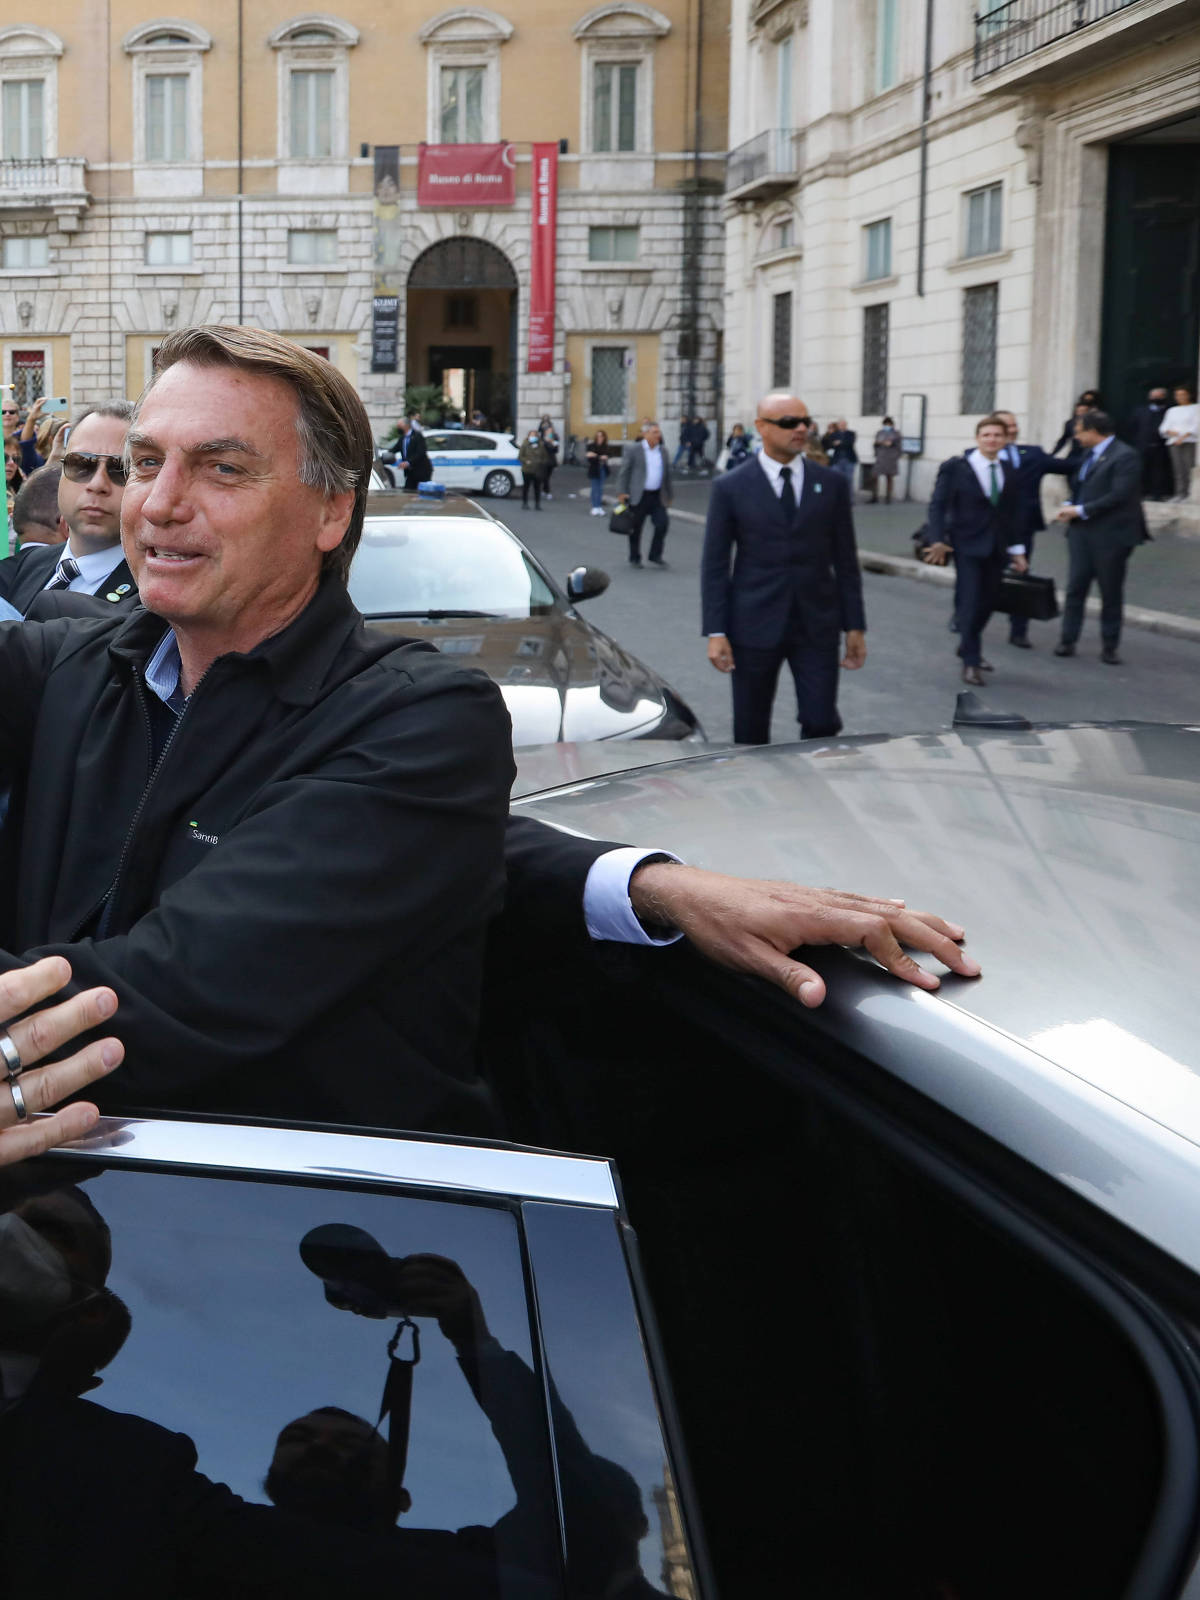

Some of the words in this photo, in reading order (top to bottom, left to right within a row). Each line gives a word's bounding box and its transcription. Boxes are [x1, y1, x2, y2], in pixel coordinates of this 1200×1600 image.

[429, 174, 460, 184] Museo
[462, 174, 472, 183] di
[475, 173, 502, 183] Roma
[539, 158, 549, 183] Roma
[539, 184, 549, 195] di
[539, 196, 549, 225] Museo
